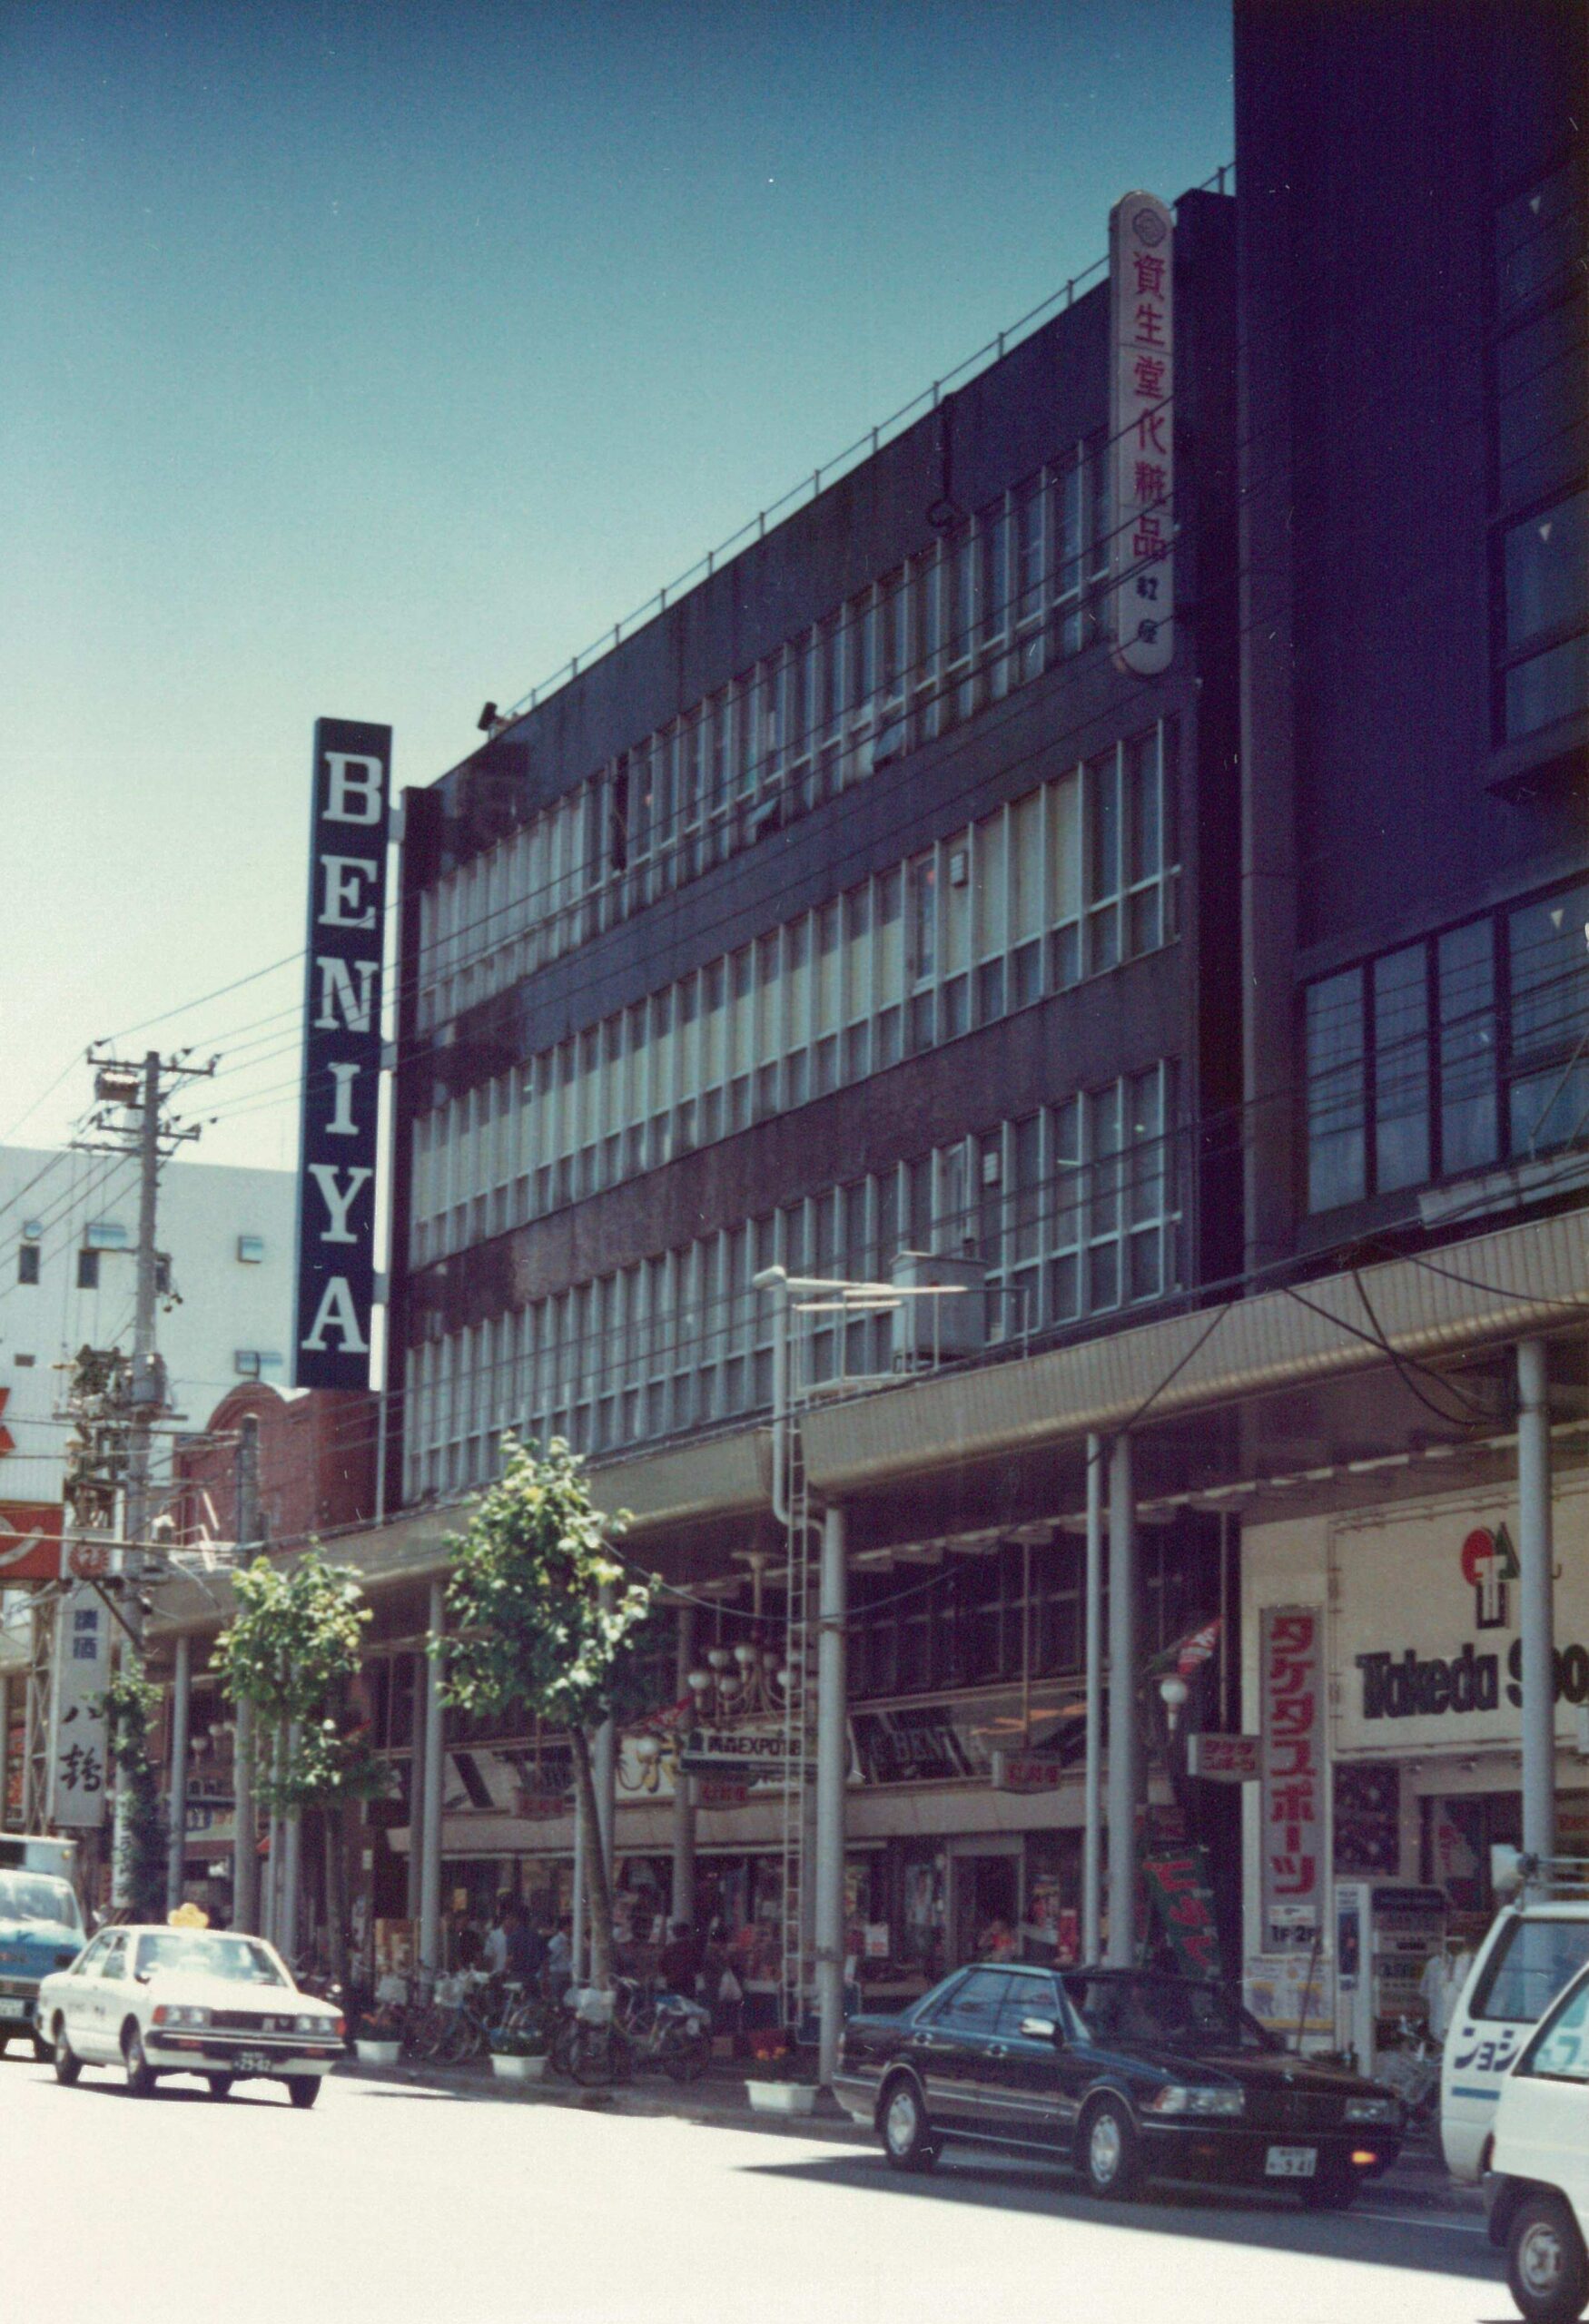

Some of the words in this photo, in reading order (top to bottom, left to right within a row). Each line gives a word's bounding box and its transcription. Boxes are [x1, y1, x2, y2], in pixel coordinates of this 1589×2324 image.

[1132, 250, 1167, 564] 資生堂化粧品
[301, 751, 384, 1354] BENIYA
[1270, 1615, 1317, 1895] タケダスポーツ
[1356, 1643, 1498, 1719] Takeda
